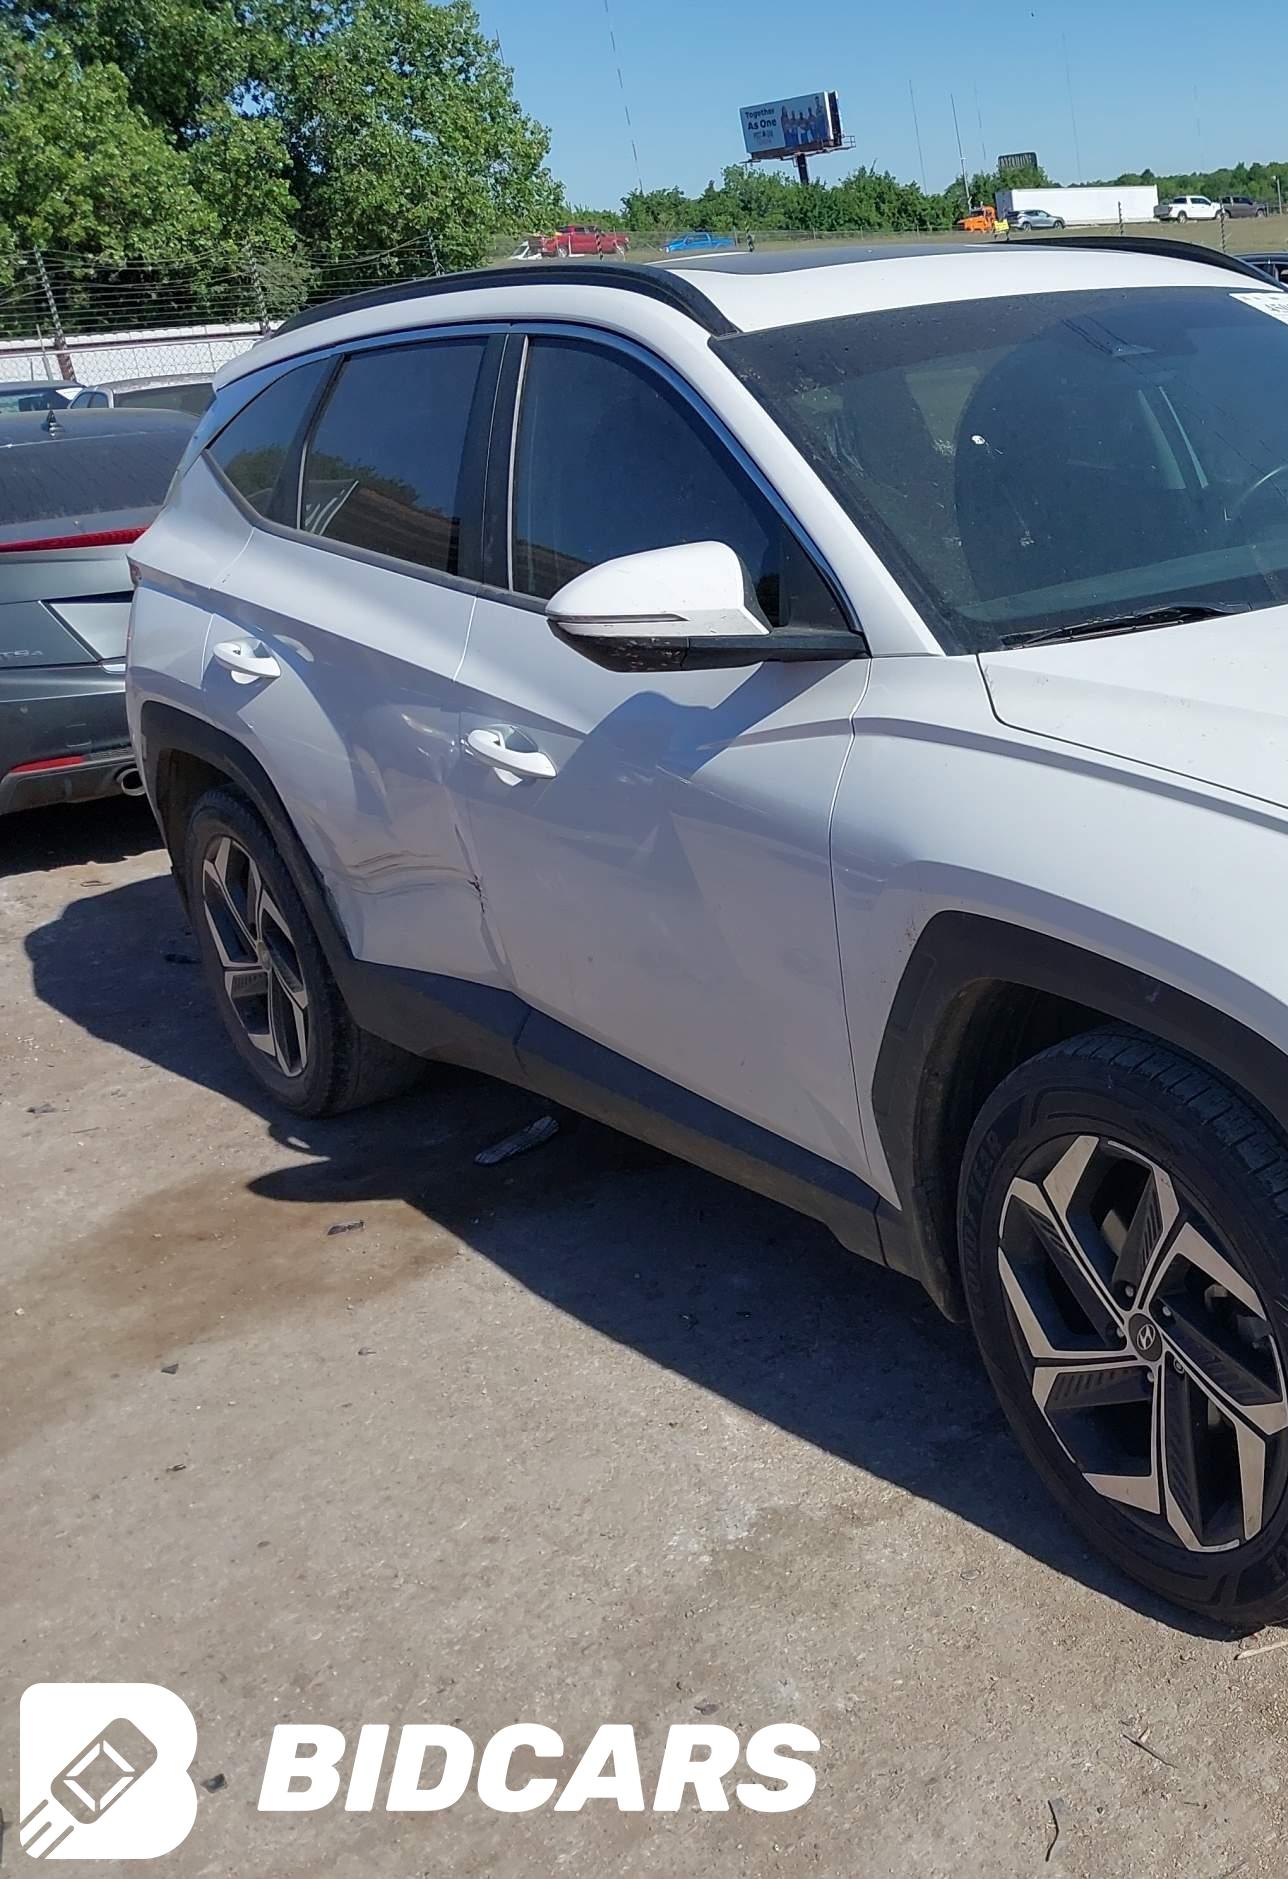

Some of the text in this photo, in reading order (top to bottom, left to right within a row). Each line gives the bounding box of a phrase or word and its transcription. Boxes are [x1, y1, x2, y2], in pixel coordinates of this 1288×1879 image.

[745, 108, 774, 119] Together
[747, 118, 777, 131] As One
